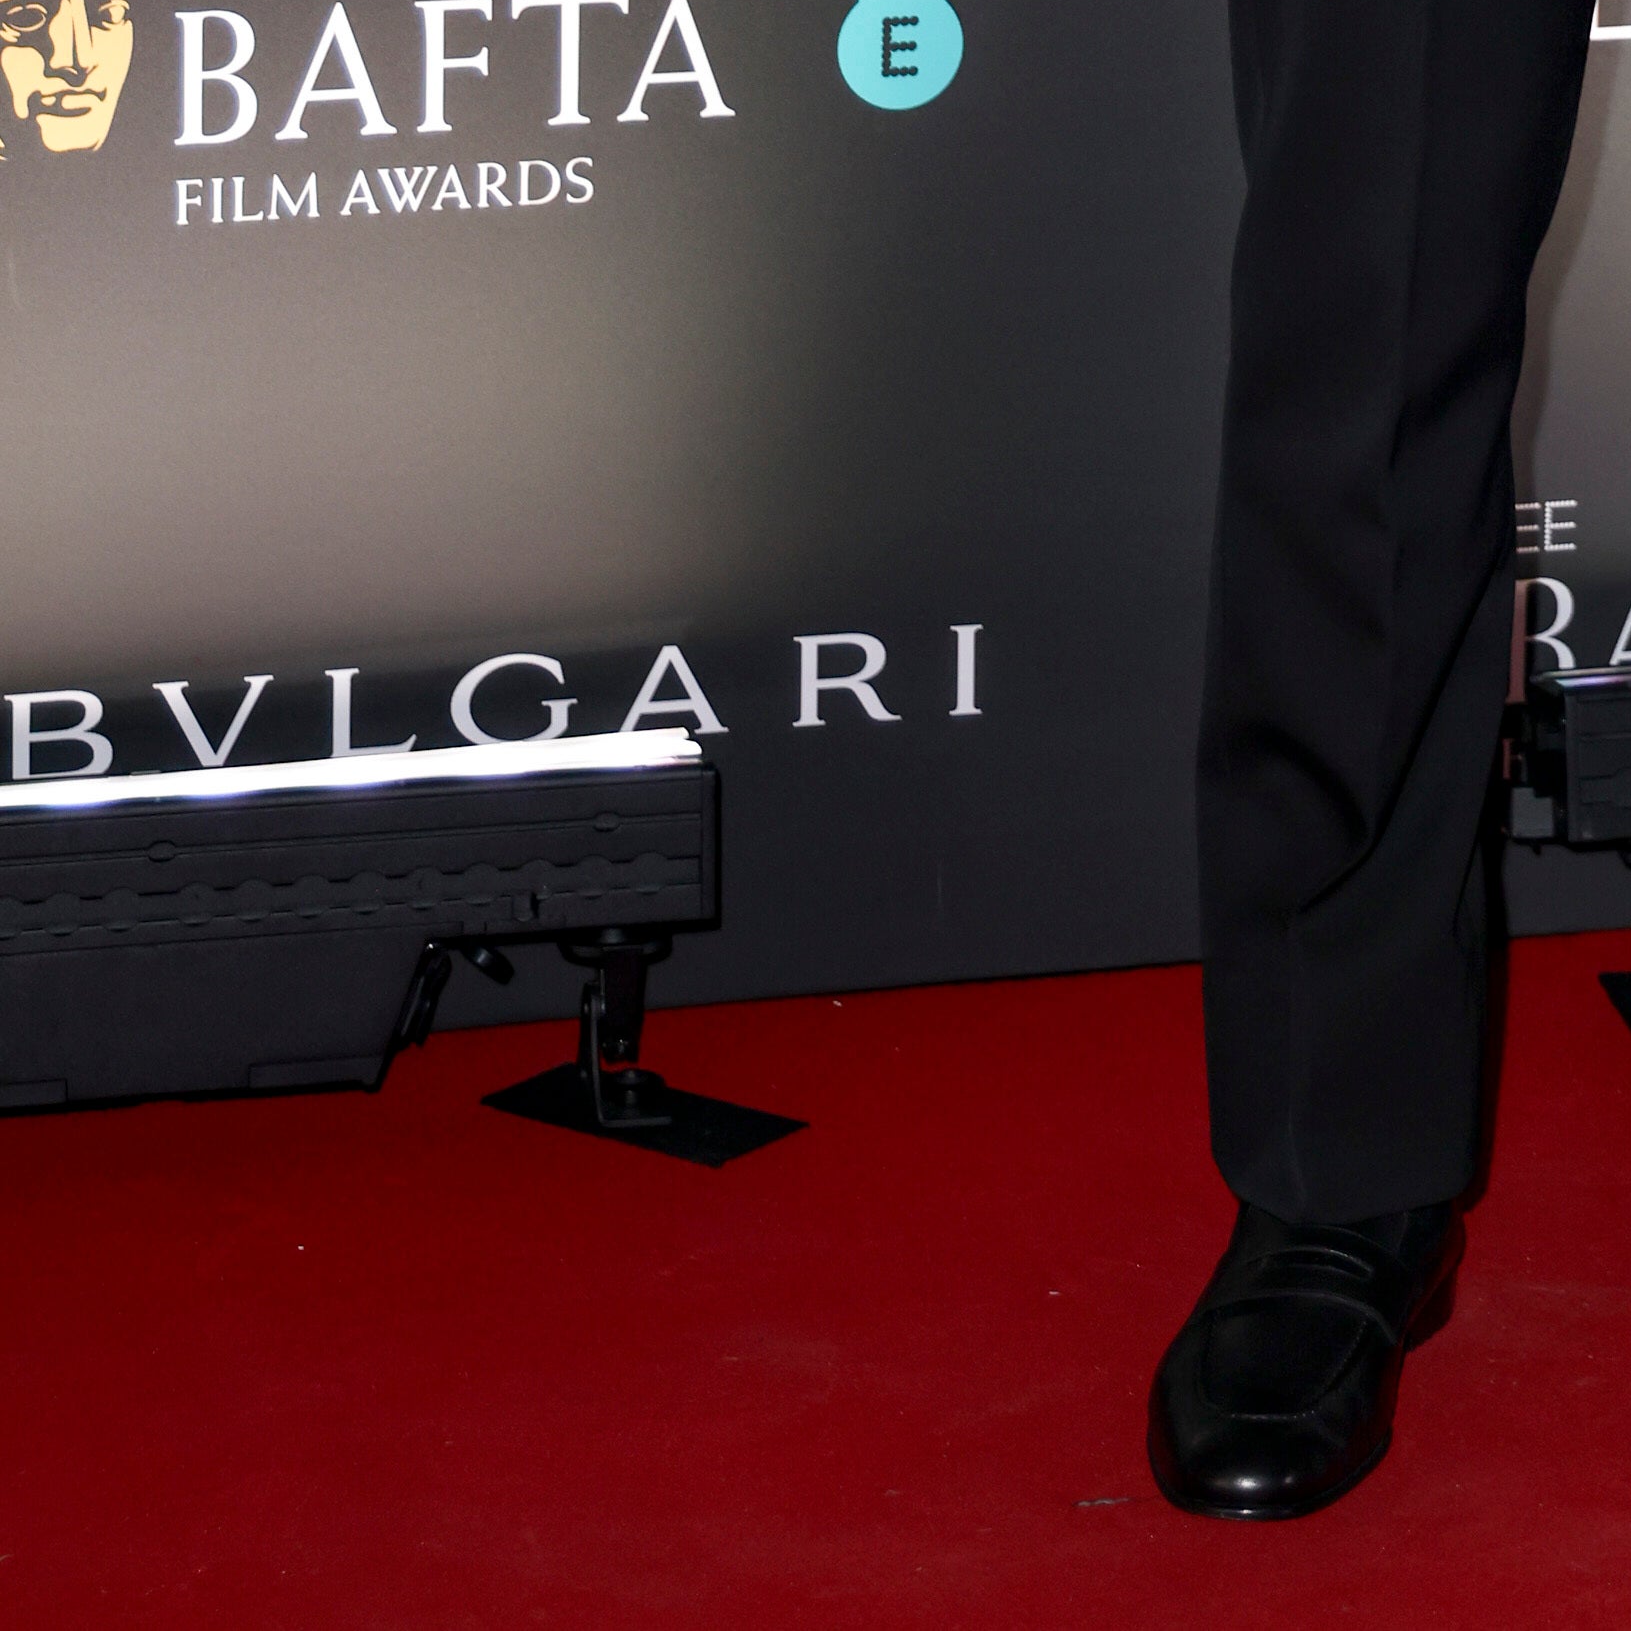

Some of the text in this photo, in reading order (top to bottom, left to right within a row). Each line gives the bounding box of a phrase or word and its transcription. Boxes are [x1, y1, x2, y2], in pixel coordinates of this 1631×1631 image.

[176, 157, 593, 225] FILM AWARDS
[4, 625, 981, 781] BVLGARI
